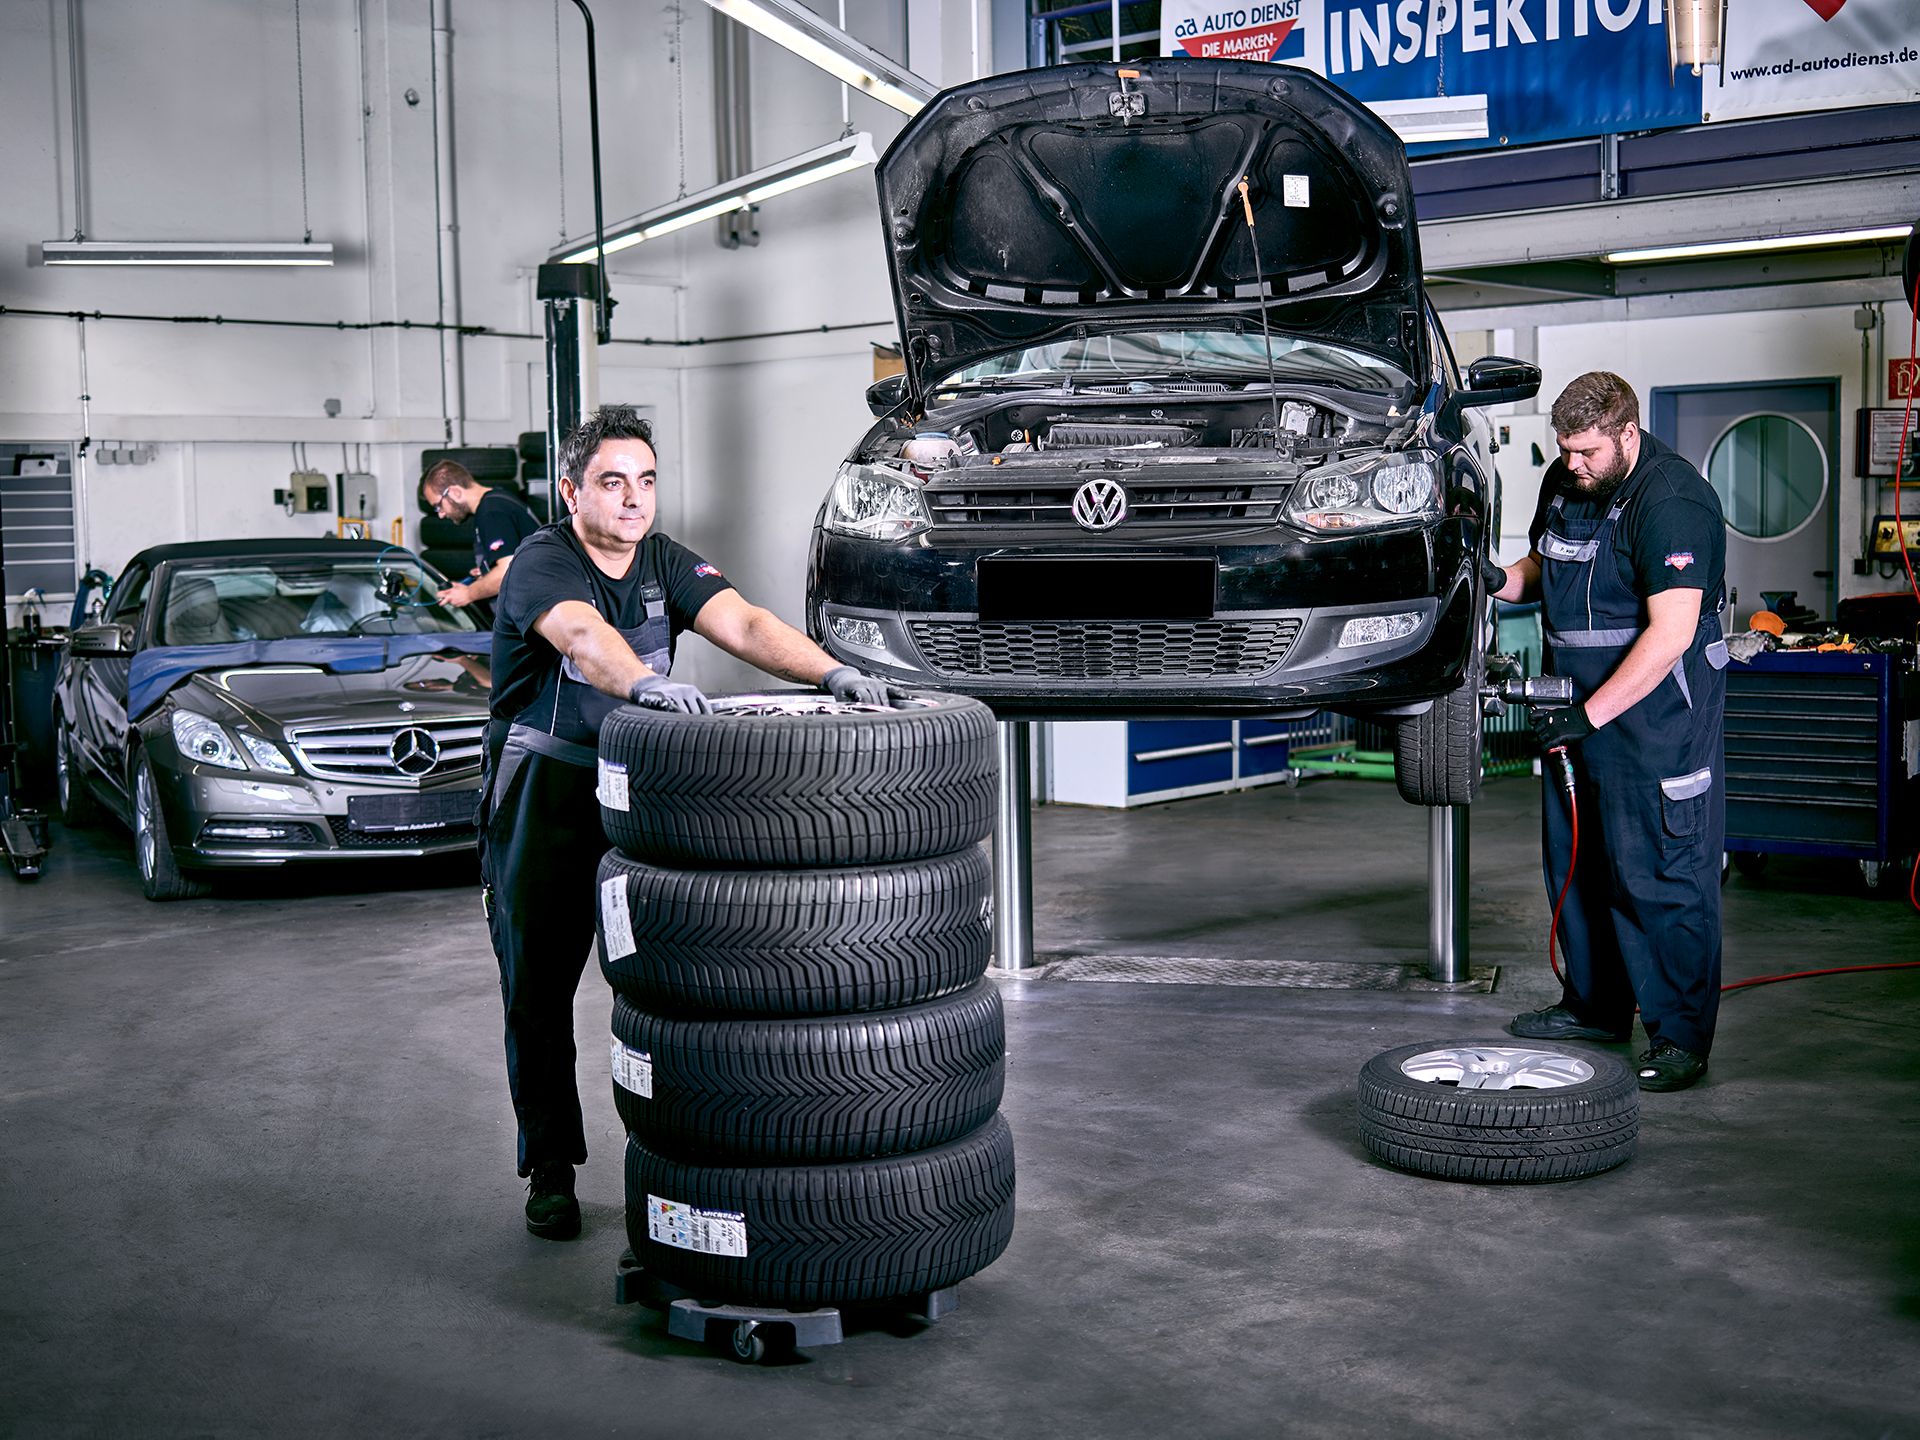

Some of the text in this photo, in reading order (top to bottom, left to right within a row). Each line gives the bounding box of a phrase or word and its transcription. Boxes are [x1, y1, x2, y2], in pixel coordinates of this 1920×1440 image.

[1203, 10, 1246, 32] AUTO
[1251, 0, 1300, 24] DIENST
[1202, 32, 1277, 57] DIE MARKEN-
[1730, 47, 1918, 80] www.ad-autodienst.de
